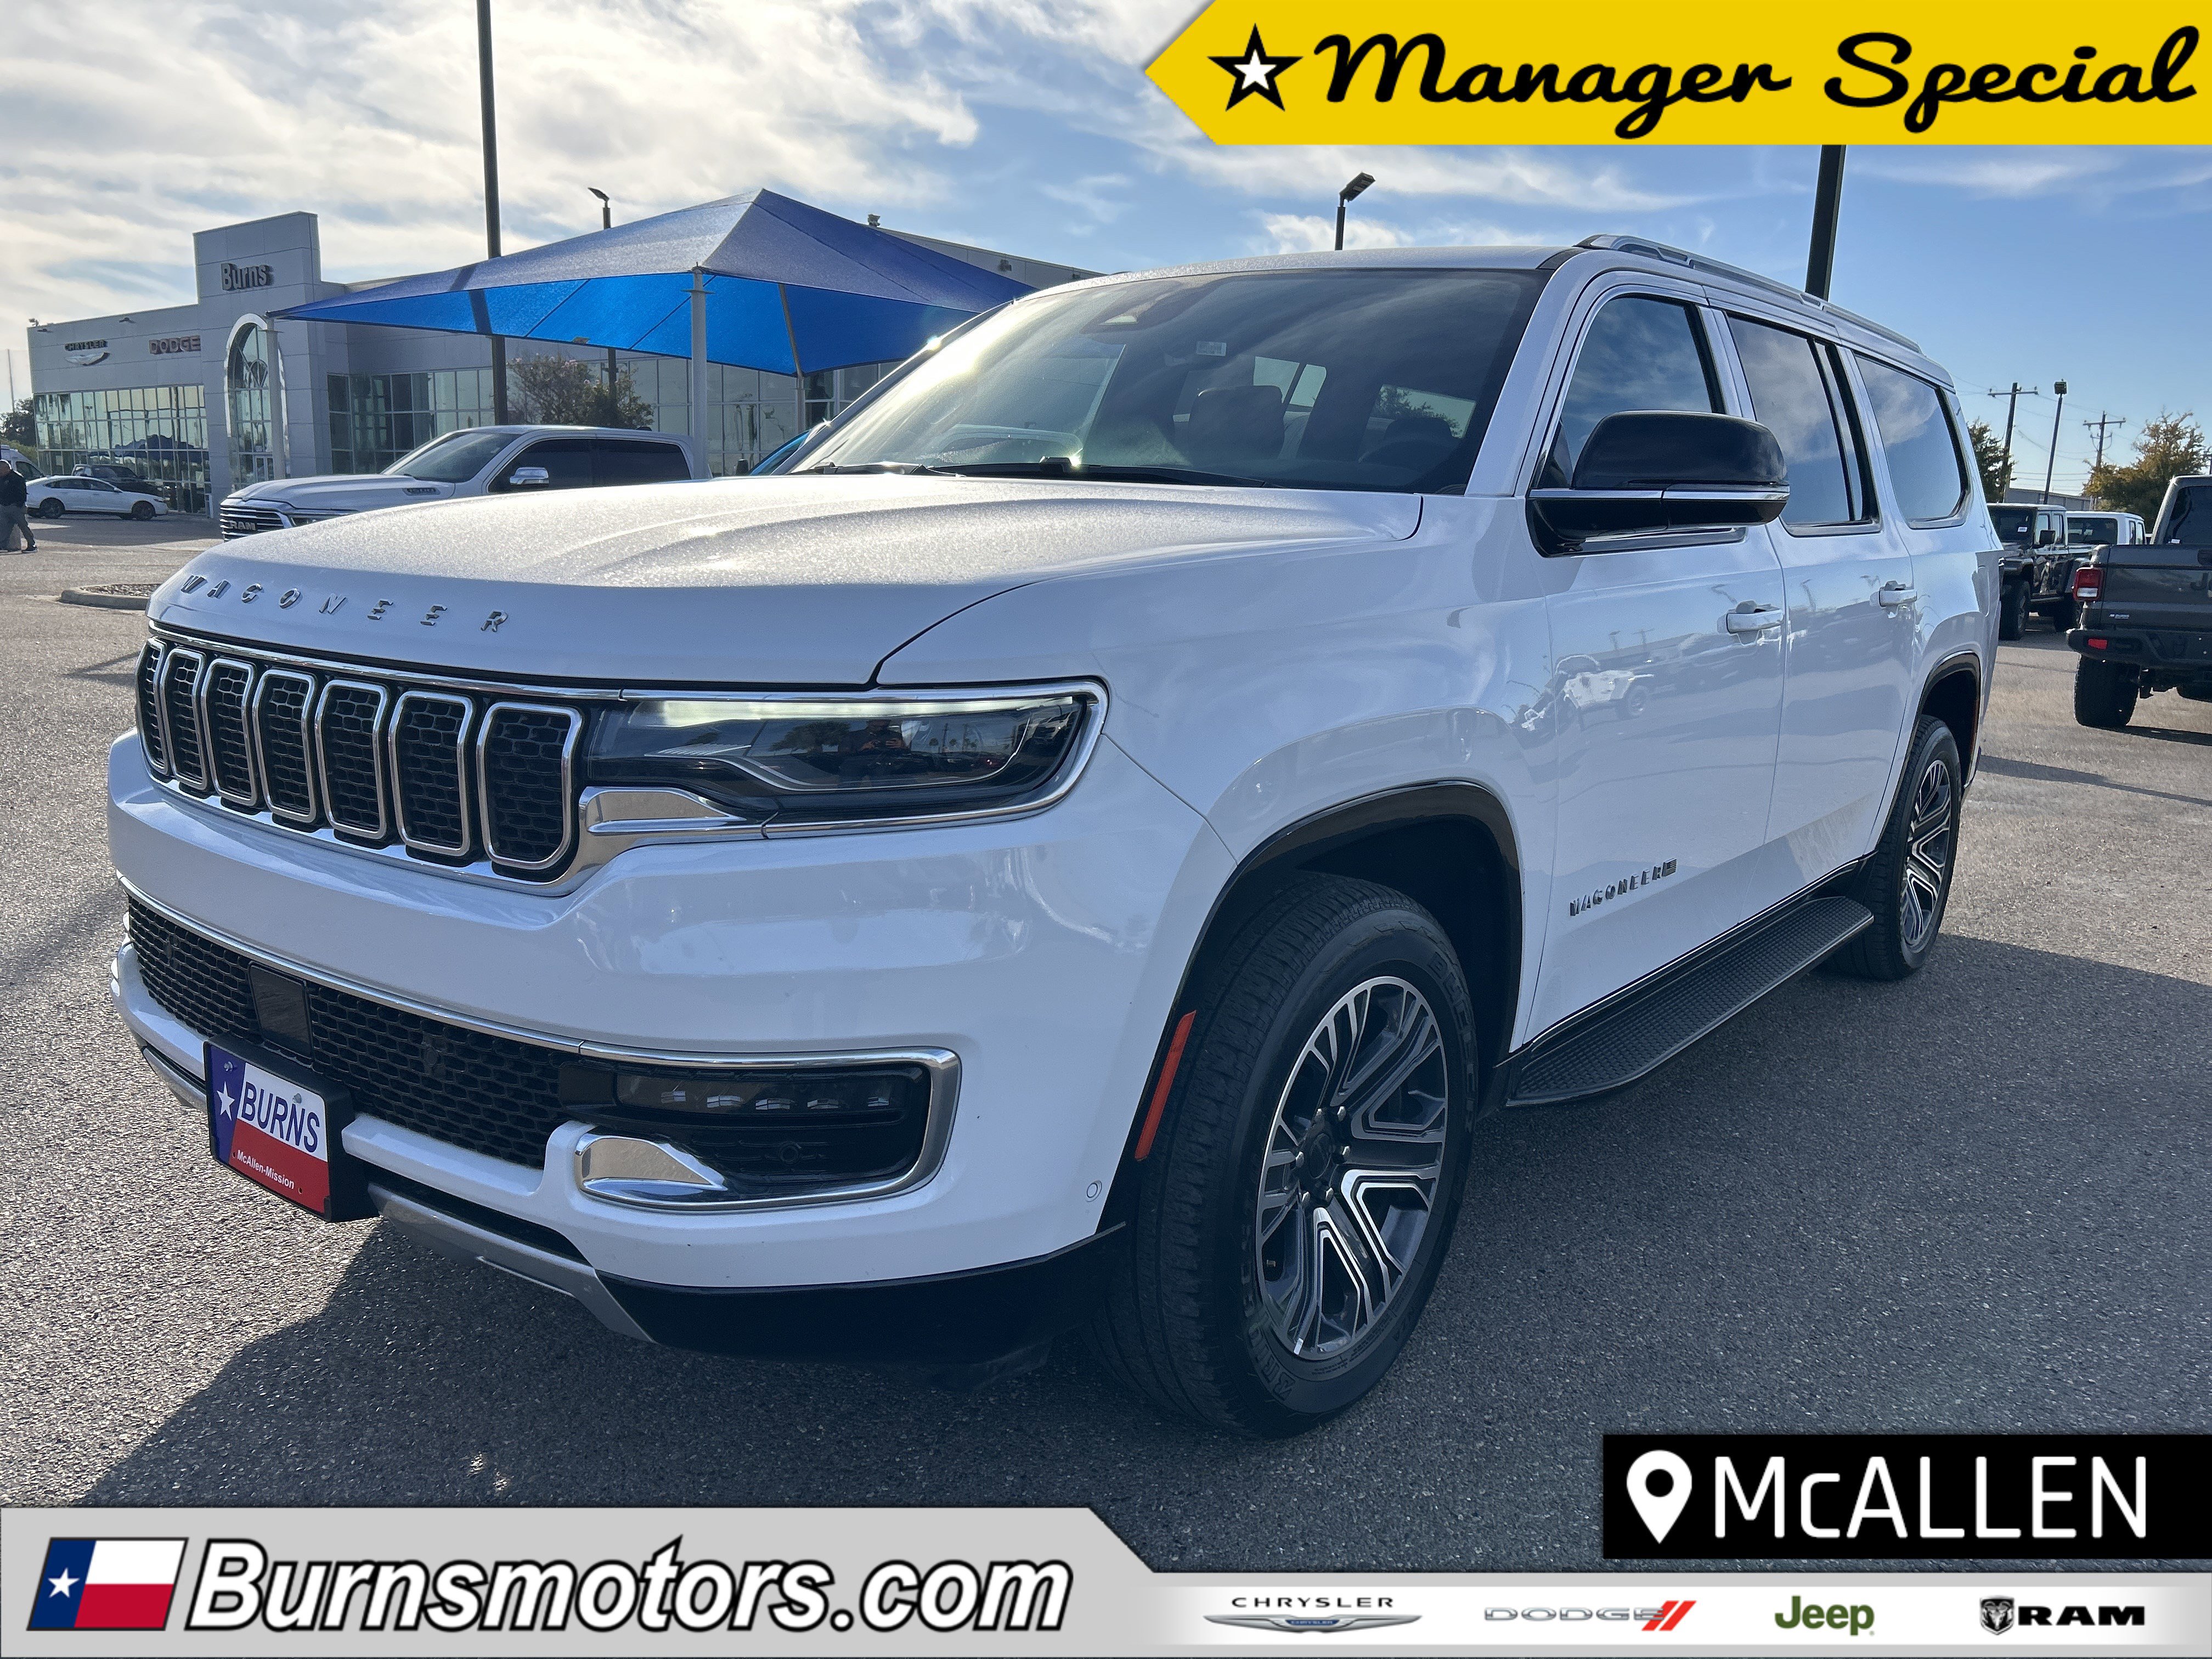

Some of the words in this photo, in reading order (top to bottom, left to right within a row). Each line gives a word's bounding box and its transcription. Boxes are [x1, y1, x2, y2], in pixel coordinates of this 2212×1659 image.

[221, 263, 271, 291] Burns
[64, 339, 108, 351] CHRYSLER
[149, 335, 201, 354] DODGE
[180, 574, 509, 633] WAGONEER
[1570, 865, 1662, 917] WAGONEER
[241, 1081, 320, 1153] BURNS
[236, 1149, 295, 1190] McAllen-Mission
